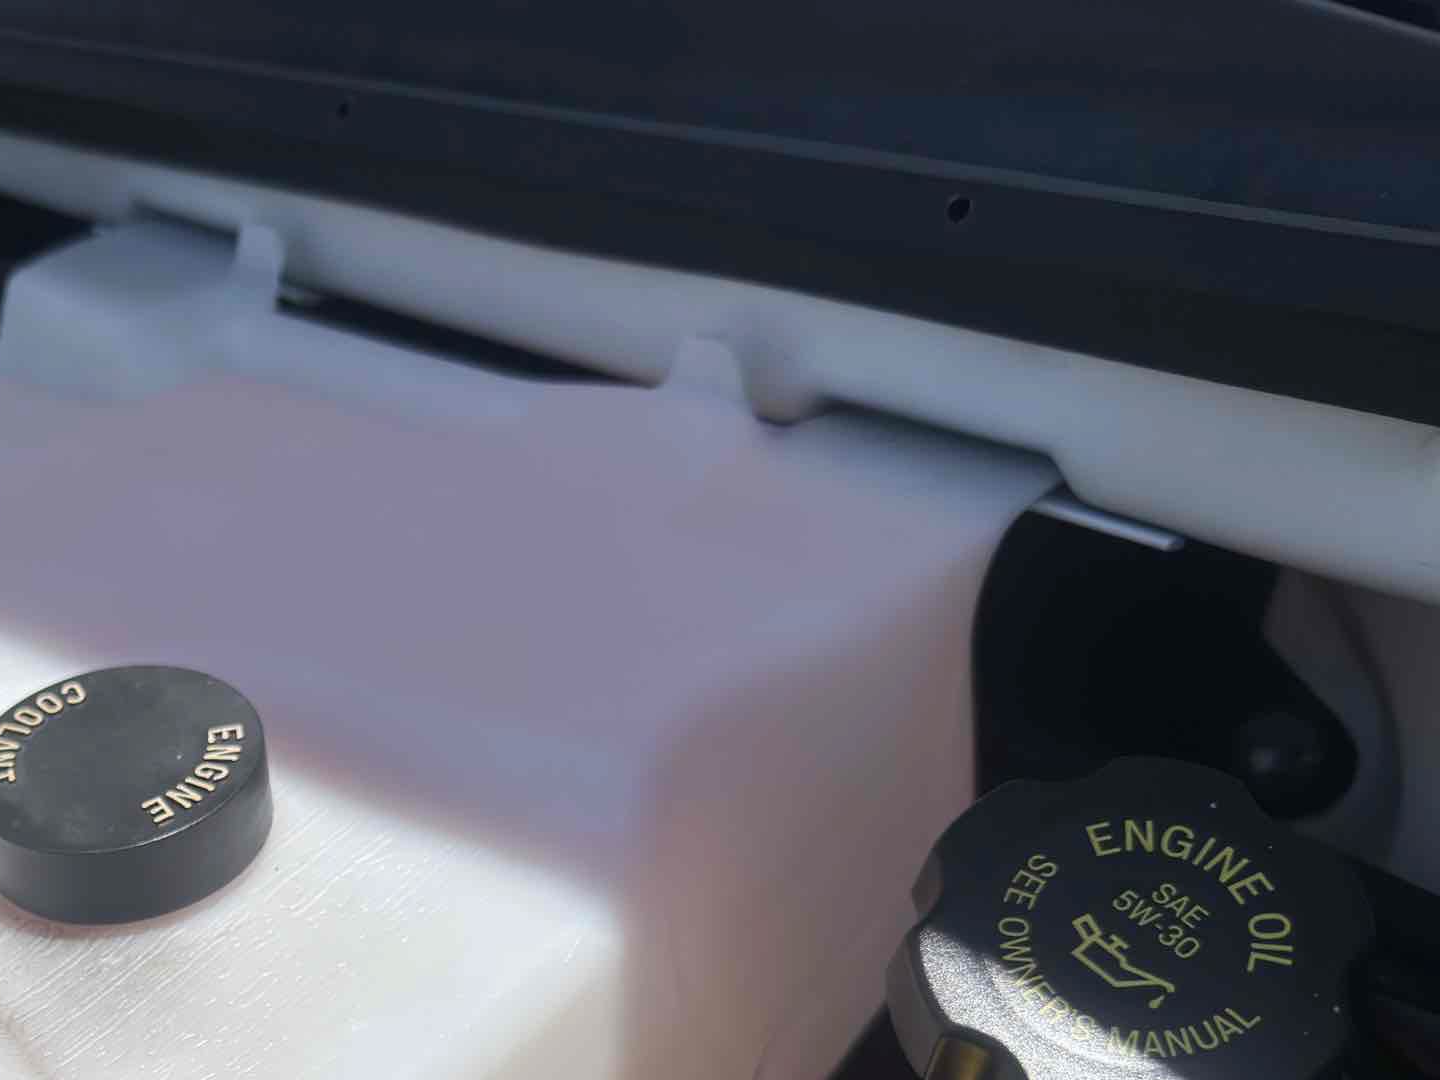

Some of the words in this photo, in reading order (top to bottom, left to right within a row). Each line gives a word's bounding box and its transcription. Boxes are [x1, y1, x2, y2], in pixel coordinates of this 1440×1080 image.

[141, 723, 244, 825] ENGINE
[1085, 819, 1275, 905] ENGINE
[1247, 912, 1294, 972] OIL
[1112, 888, 1201, 960] 5W-30
[1151, 883, 1209, 929] SAE
[1003, 854, 1058, 910] SEE
[1104, 1007, 1262, 1058] MANUAL
